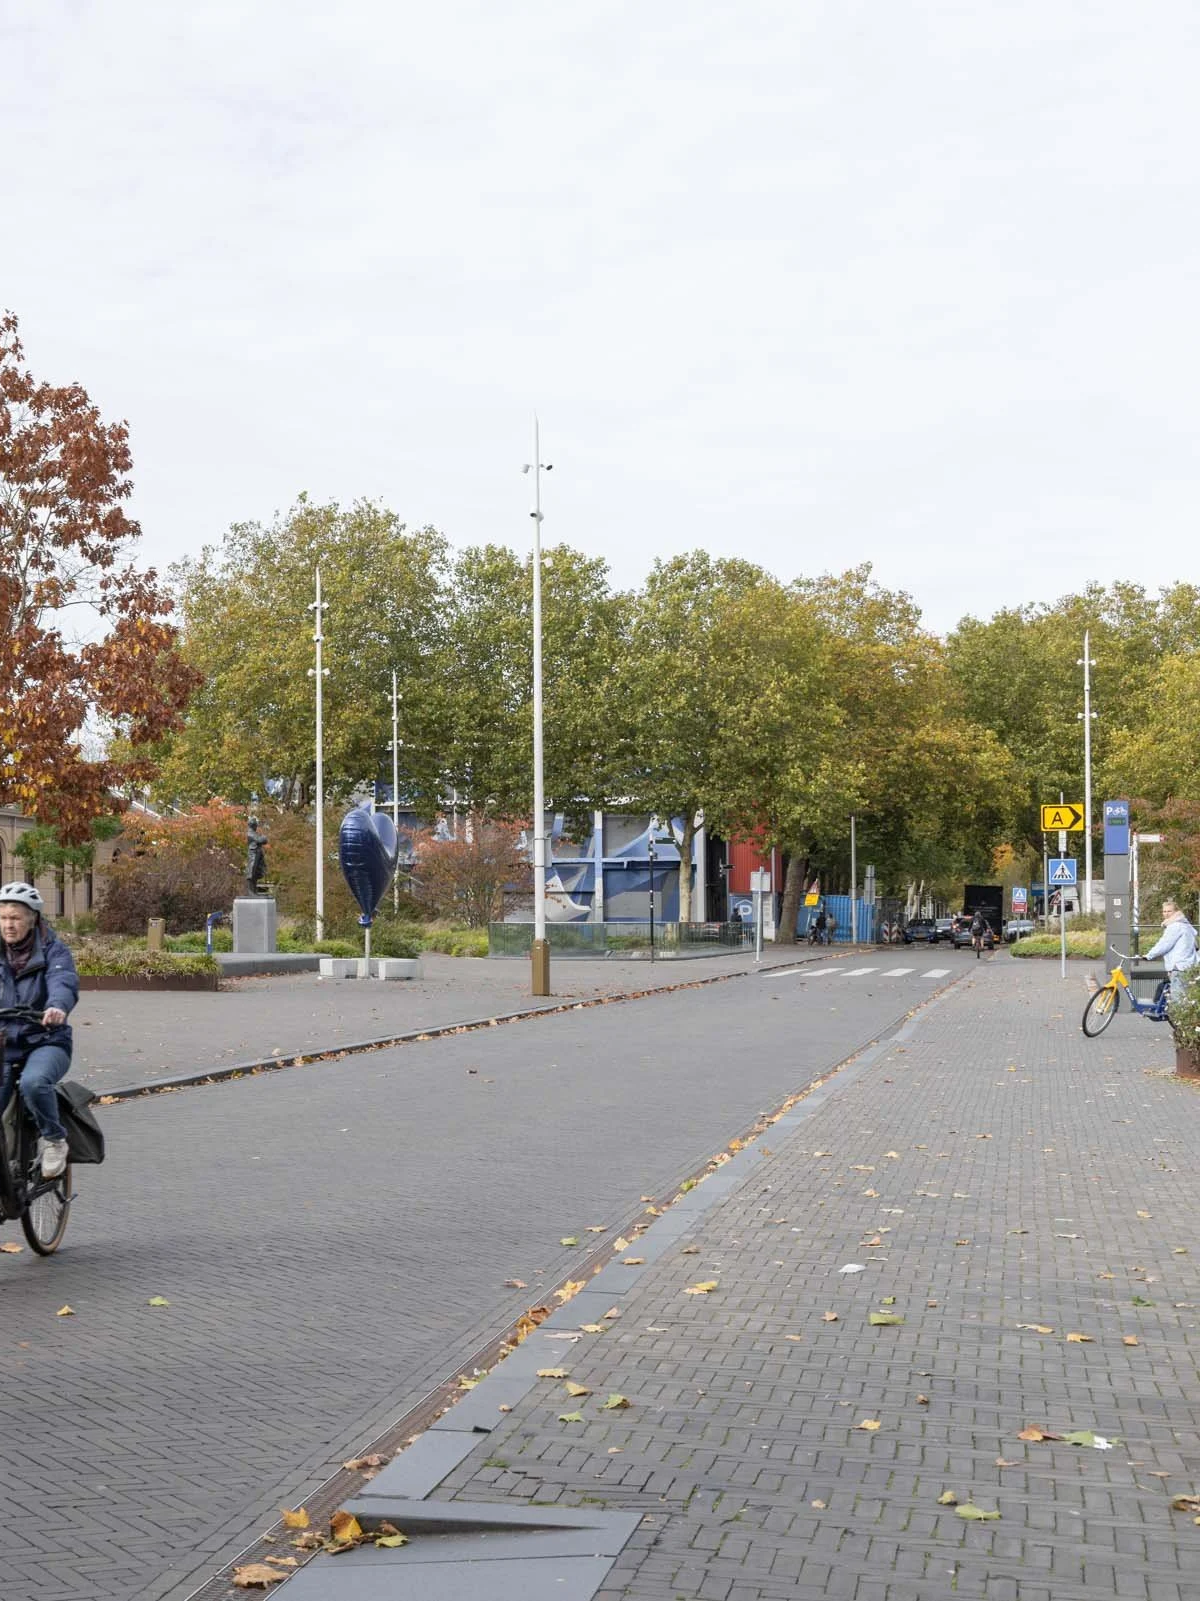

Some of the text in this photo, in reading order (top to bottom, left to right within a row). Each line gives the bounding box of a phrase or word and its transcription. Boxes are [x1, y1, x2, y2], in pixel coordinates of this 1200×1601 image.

[1051, 811, 1064, 825] A
[1106, 806, 1113, 816] P
[739, 904, 753, 920] P
